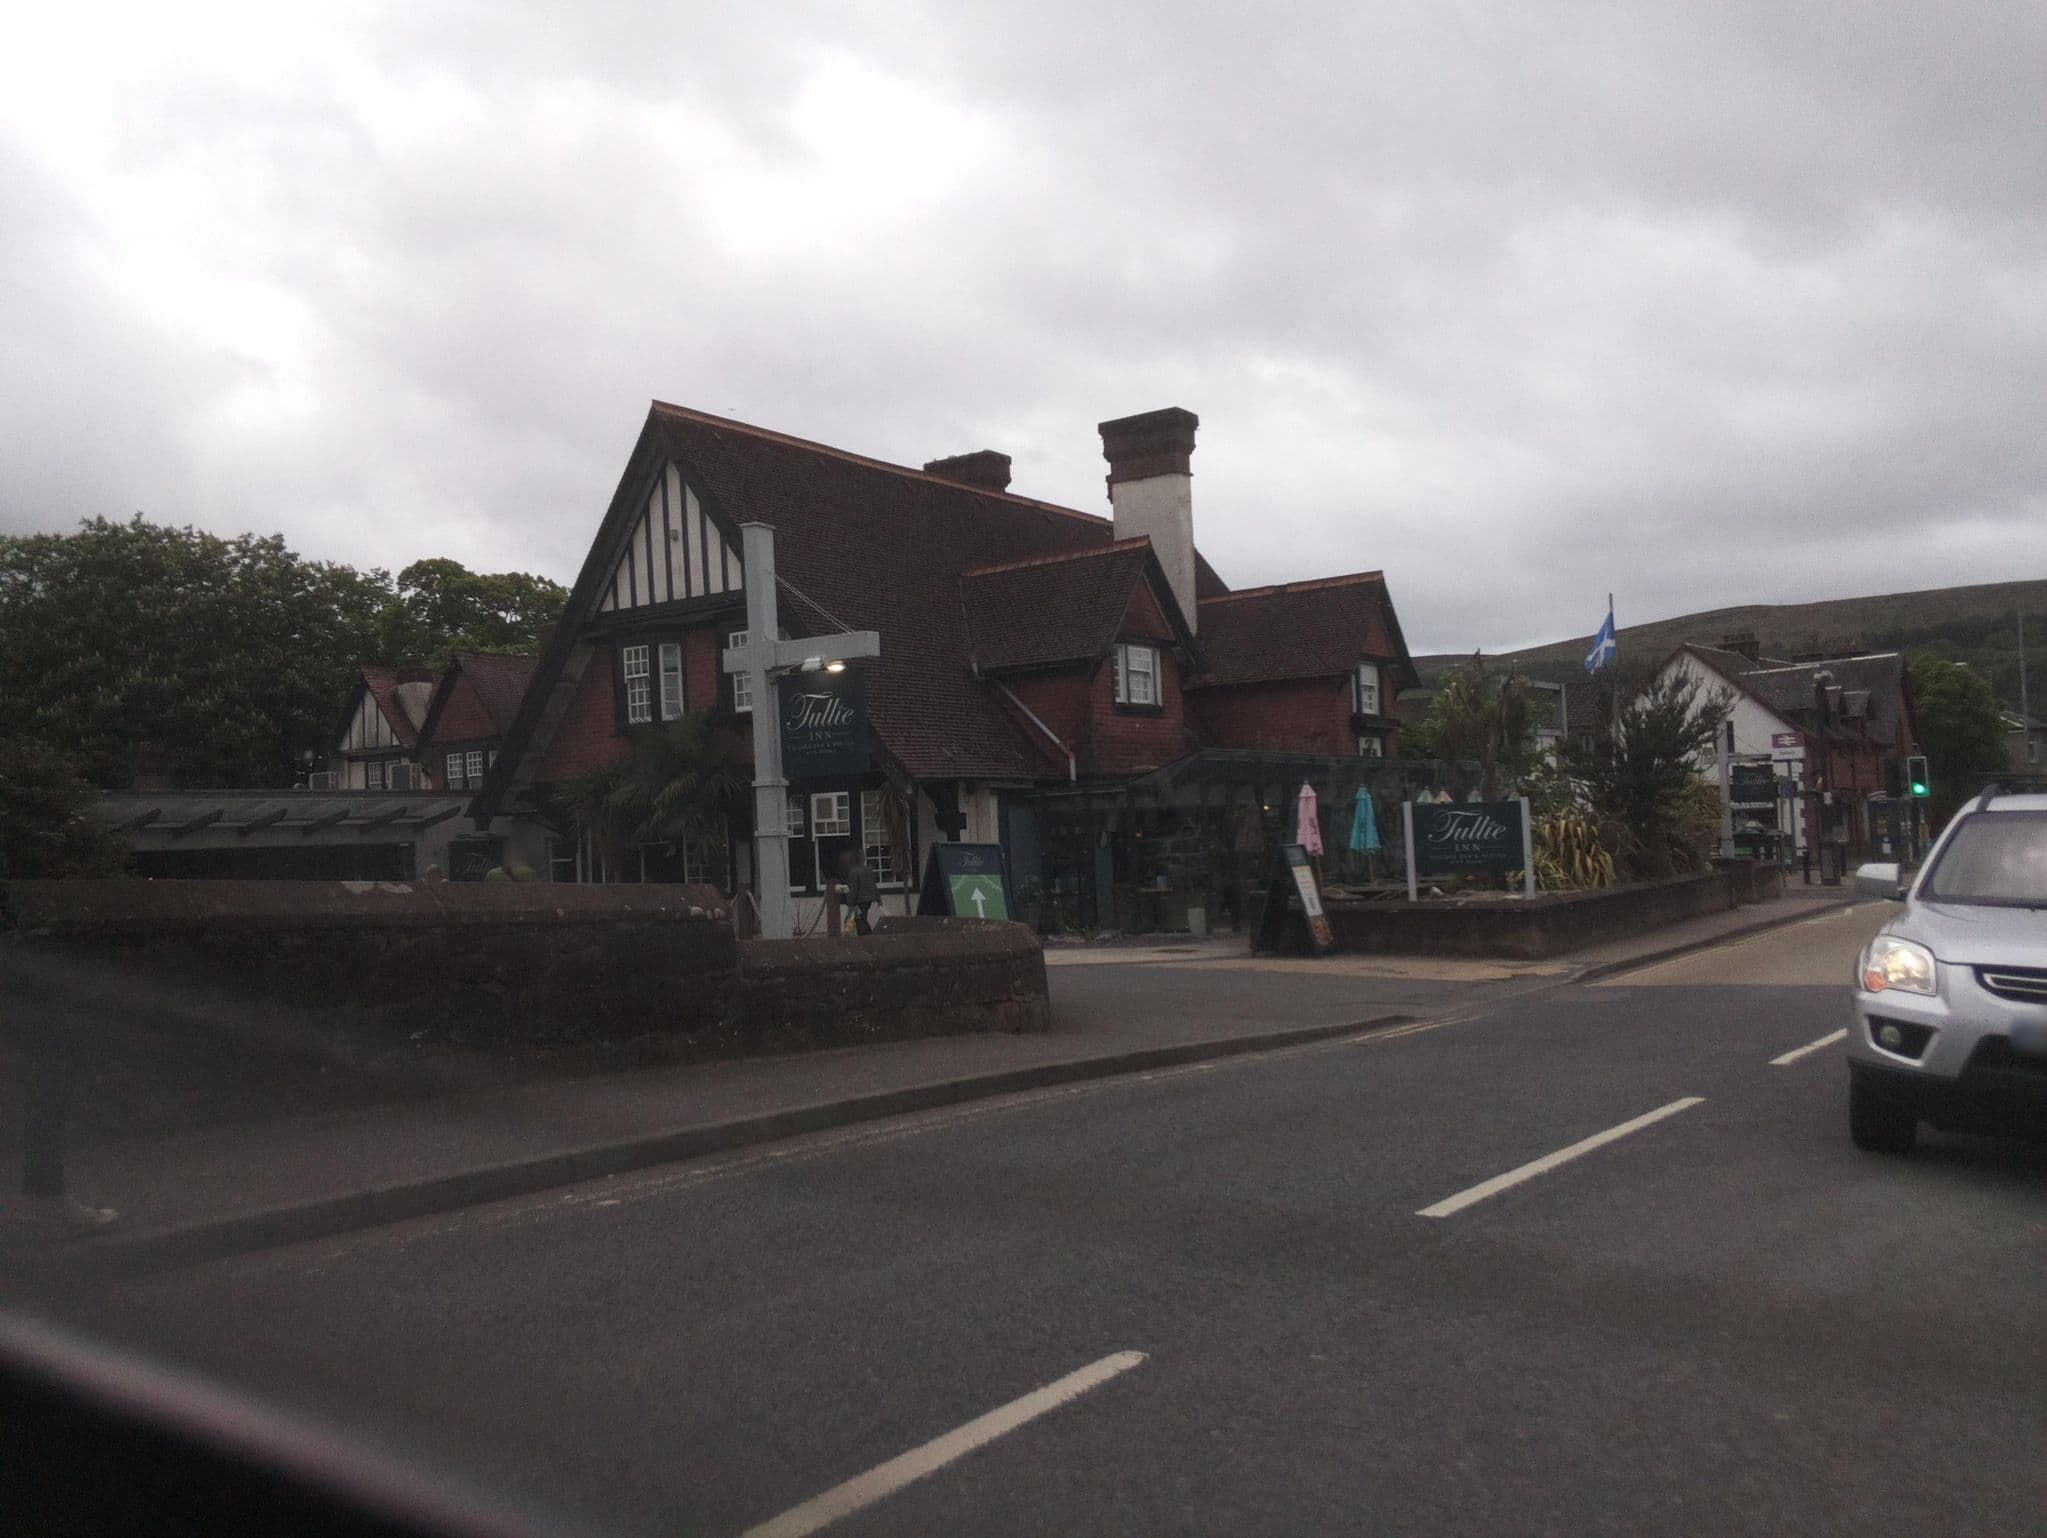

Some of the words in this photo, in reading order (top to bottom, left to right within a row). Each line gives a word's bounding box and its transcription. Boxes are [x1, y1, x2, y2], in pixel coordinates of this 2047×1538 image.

[786, 691, 856, 731] Tullie
[809, 729, 832, 741] INN
[1426, 809, 1506, 842] Tullie
[959, 852, 985, 868] Tullie
